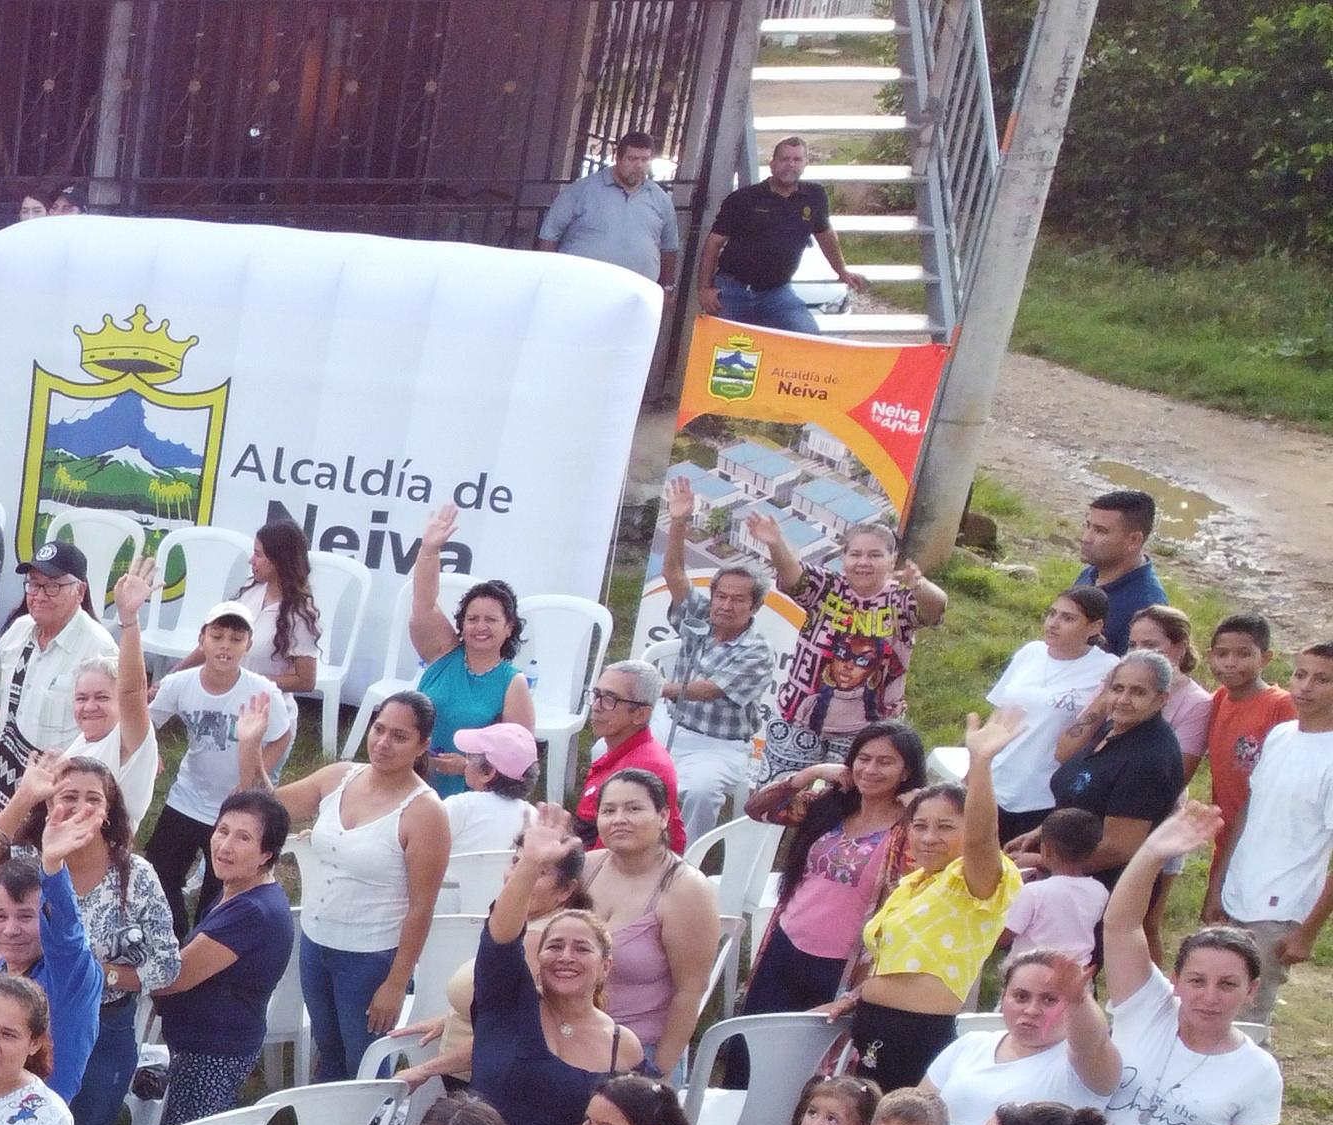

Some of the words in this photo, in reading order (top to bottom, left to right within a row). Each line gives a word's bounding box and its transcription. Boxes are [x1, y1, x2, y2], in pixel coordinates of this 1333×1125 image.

[770, 367, 820, 383] Alcaldía
[823, 374, 840, 385] de
[777, 381, 829, 400] Neiva
[871, 401, 921, 422] Neiva
[230, 443, 433, 504] Alcaldía
[453, 472, 513, 514] de
[1173, 1104, 1198, 1122] the
